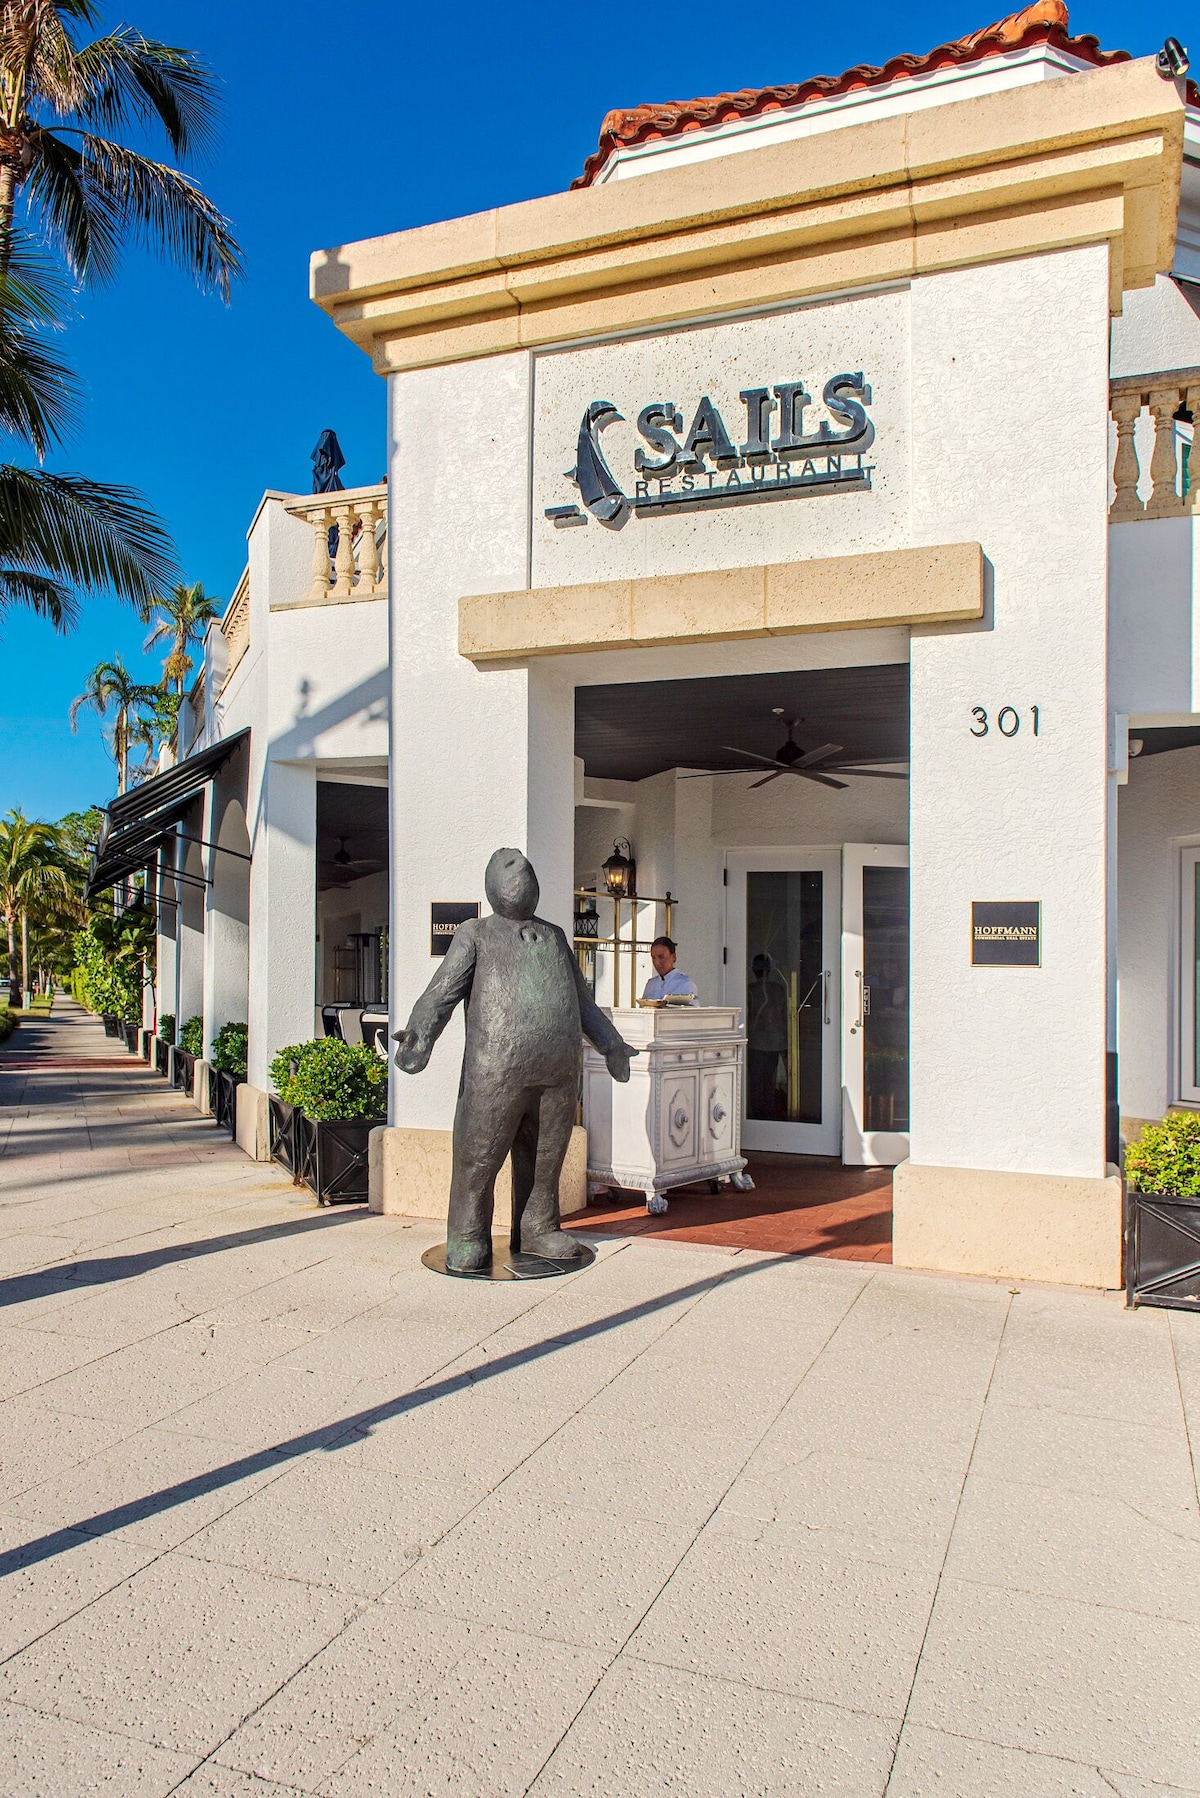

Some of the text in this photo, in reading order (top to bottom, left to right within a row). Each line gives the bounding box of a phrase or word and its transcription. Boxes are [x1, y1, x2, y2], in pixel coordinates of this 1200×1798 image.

[635, 371, 869, 472] SAILS
[635, 452, 867, 499] RESTAURANT
[969, 705, 1039, 738] 301
[433, 923, 460, 931] HOFFM
[974, 926, 1037, 935] HOFFMANN
